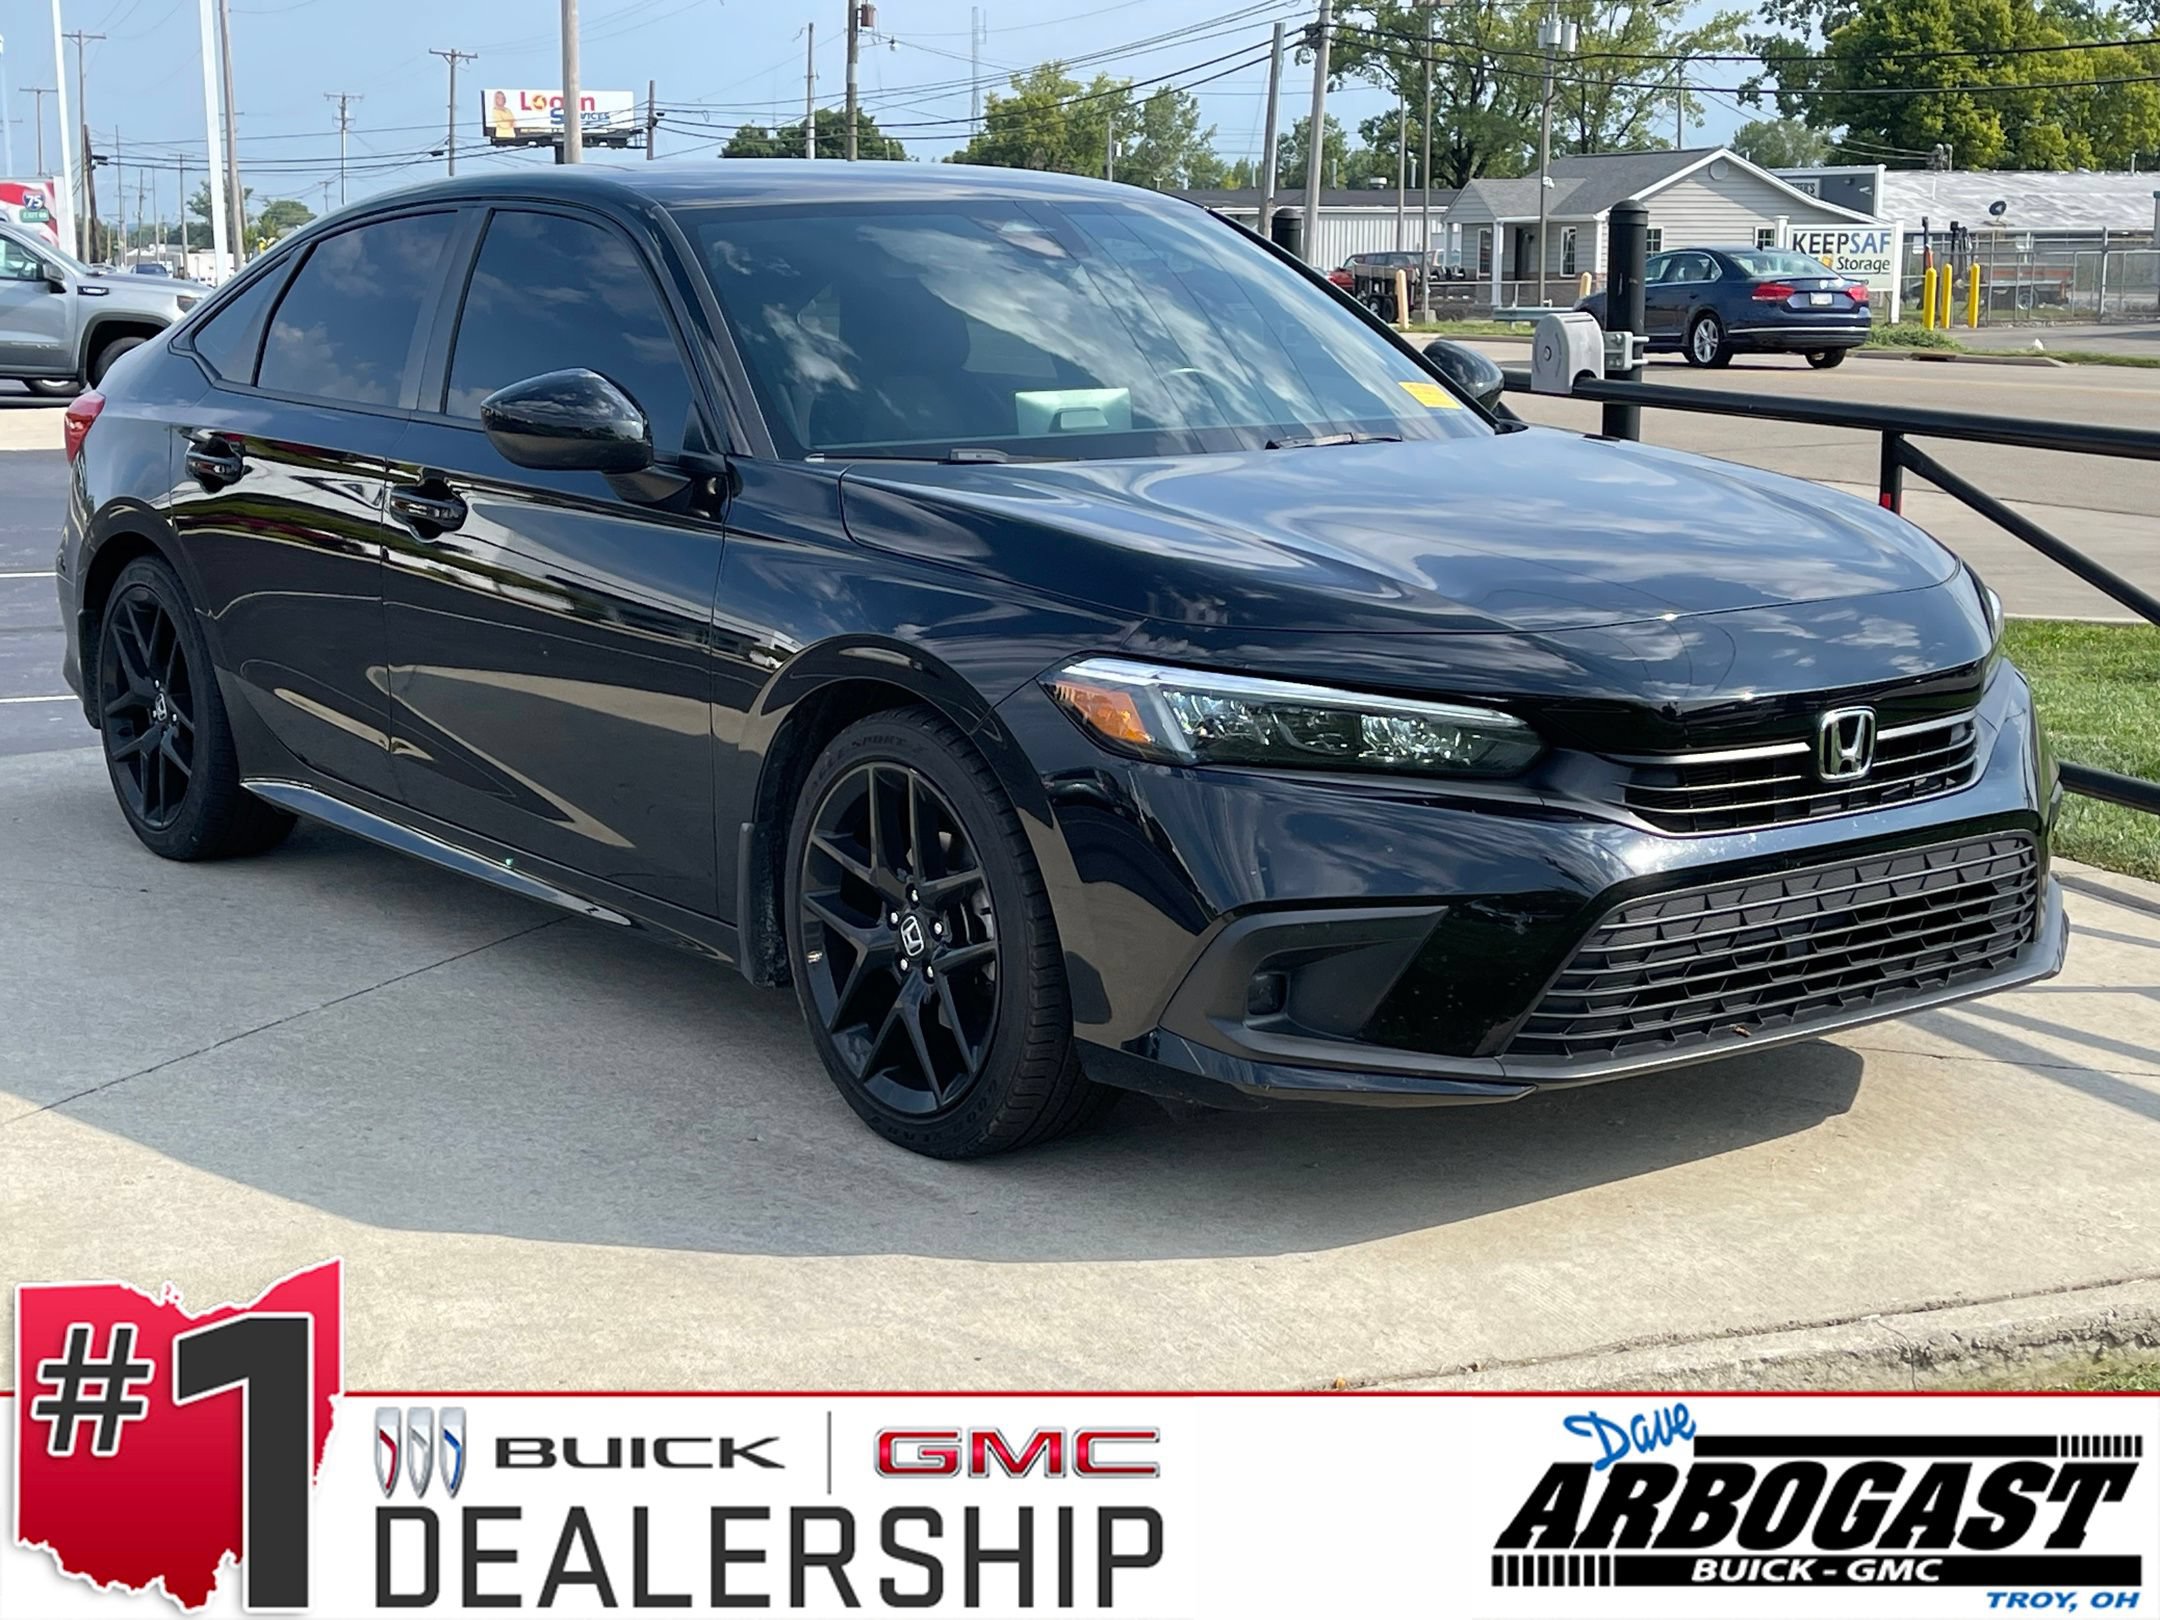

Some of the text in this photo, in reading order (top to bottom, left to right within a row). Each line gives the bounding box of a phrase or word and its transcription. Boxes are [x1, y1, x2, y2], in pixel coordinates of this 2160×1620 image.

[520, 91, 595, 111] Logn
[25, 195, 43, 208] 75
[1836, 256, 1891, 274] Storage
